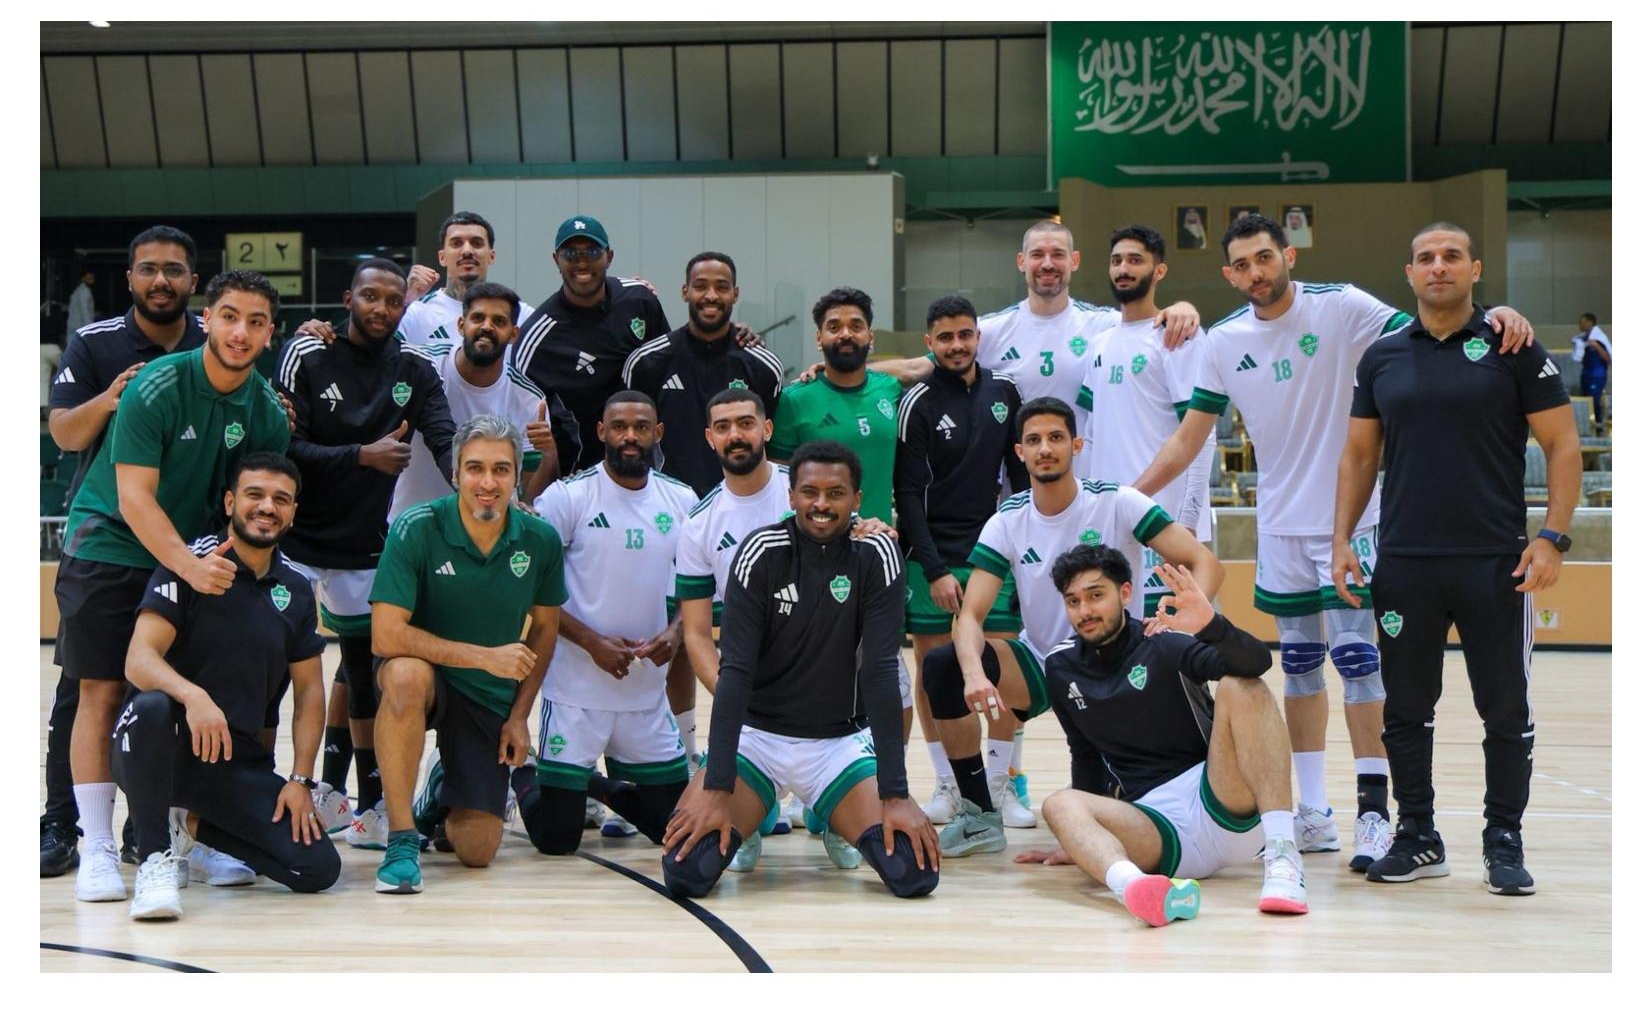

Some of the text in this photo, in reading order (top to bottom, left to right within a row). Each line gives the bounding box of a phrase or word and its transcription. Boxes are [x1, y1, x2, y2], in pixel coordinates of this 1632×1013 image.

[240, 242, 253, 263] 2
[276, 243, 289, 261] ٢
[1039, 351, 1054, 377] 3
[1272, 358, 1293, 383] 18
[1109, 365, 1125, 385] 16
[329, 400, 337, 412] 7
[857, 417, 870, 436] 5
[944, 429, 952, 440] 2
[625, 529, 645, 550] 13
[778, 601, 793, 616] 14
[1075, 698, 1088, 710] 12
